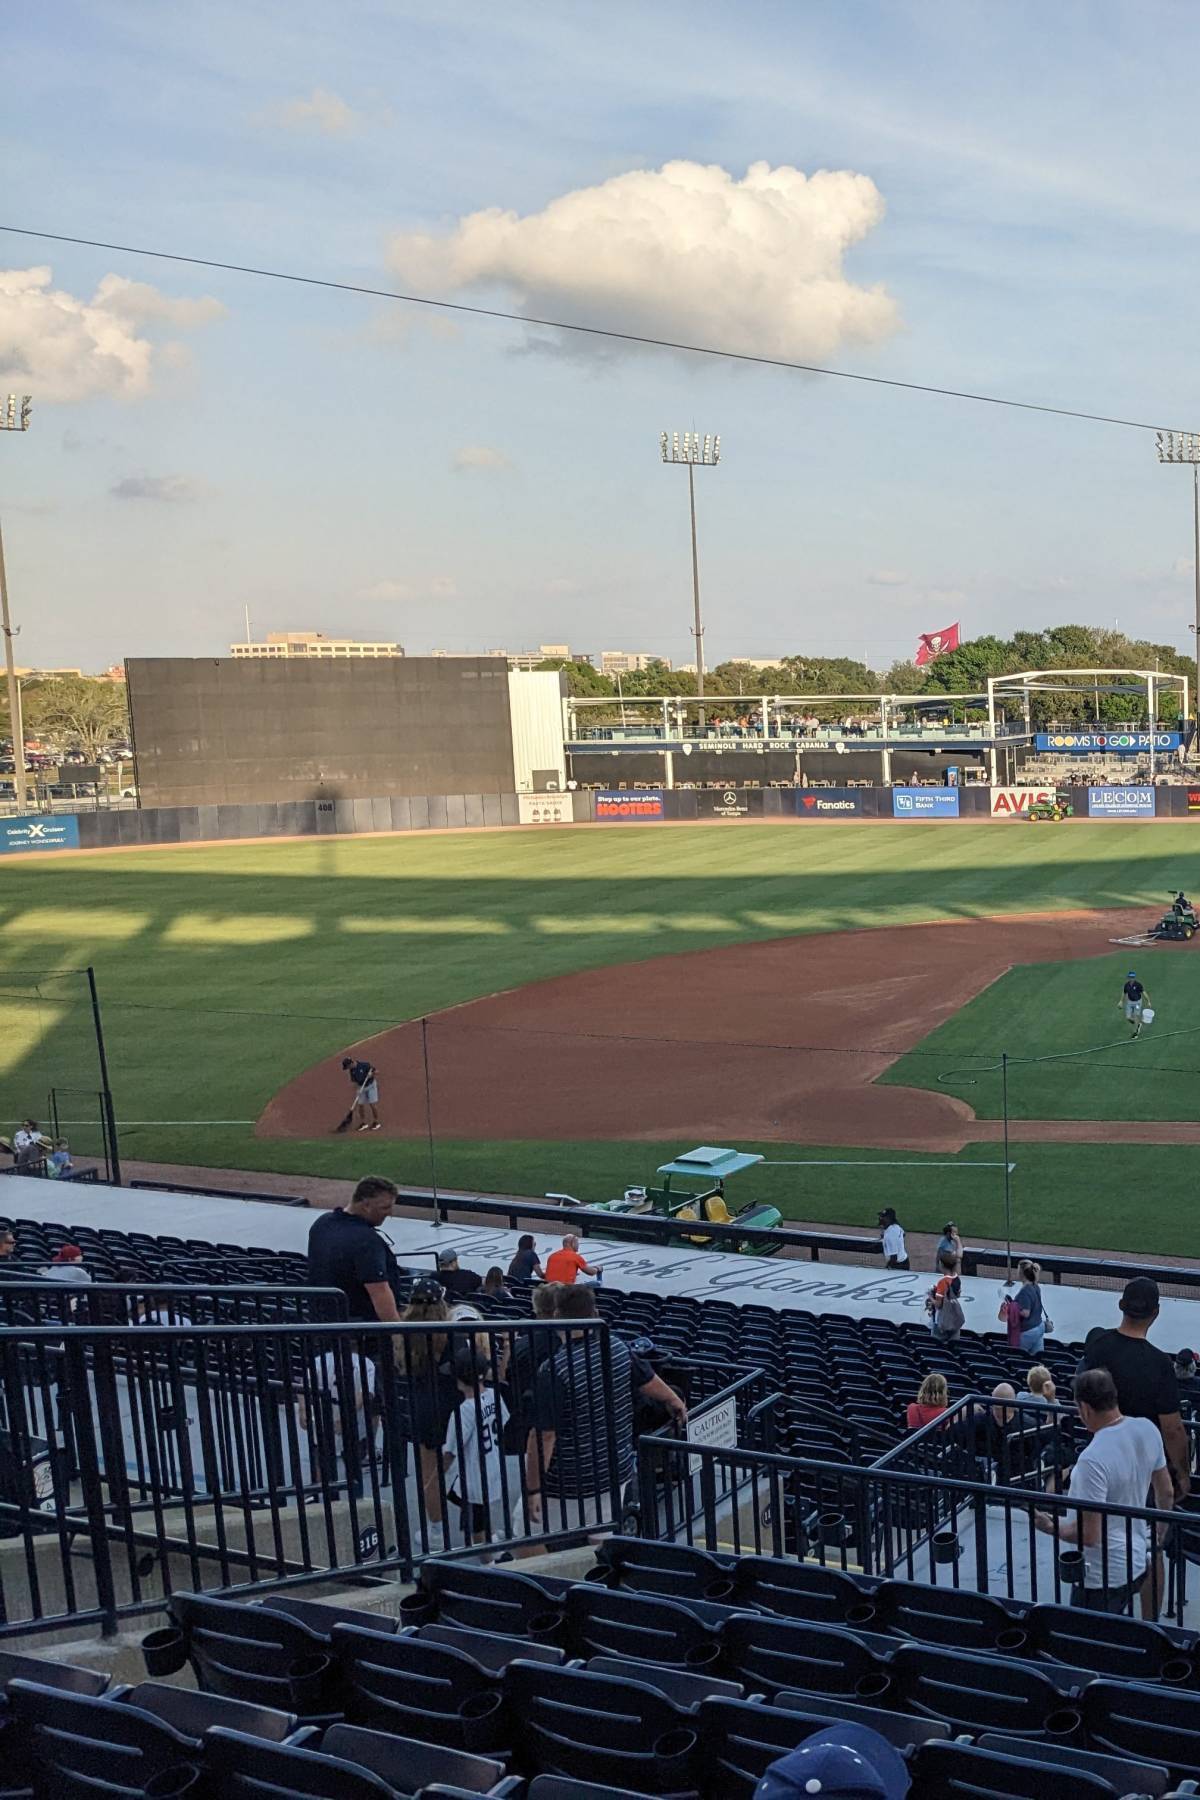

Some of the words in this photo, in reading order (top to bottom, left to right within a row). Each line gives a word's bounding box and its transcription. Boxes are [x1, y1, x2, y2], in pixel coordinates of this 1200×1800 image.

[1048, 735, 1091, 747] ROOMS
[1092, 735, 1107, 747] TO
[1109, 735, 1128, 747] GO
[1138, 734, 1171, 746] PATIO
[817, 800, 855, 809] Fanatics
[993, 792, 1050, 812] AVIS
[1091, 792, 1152, 803] LECOM
[596, 802, 662, 816] HOOTERS
[676, 1258, 976, 1308] Yankee
[694, 1407, 730, 1436] CAUTION
[359, 1531, 379, 1553] 216
